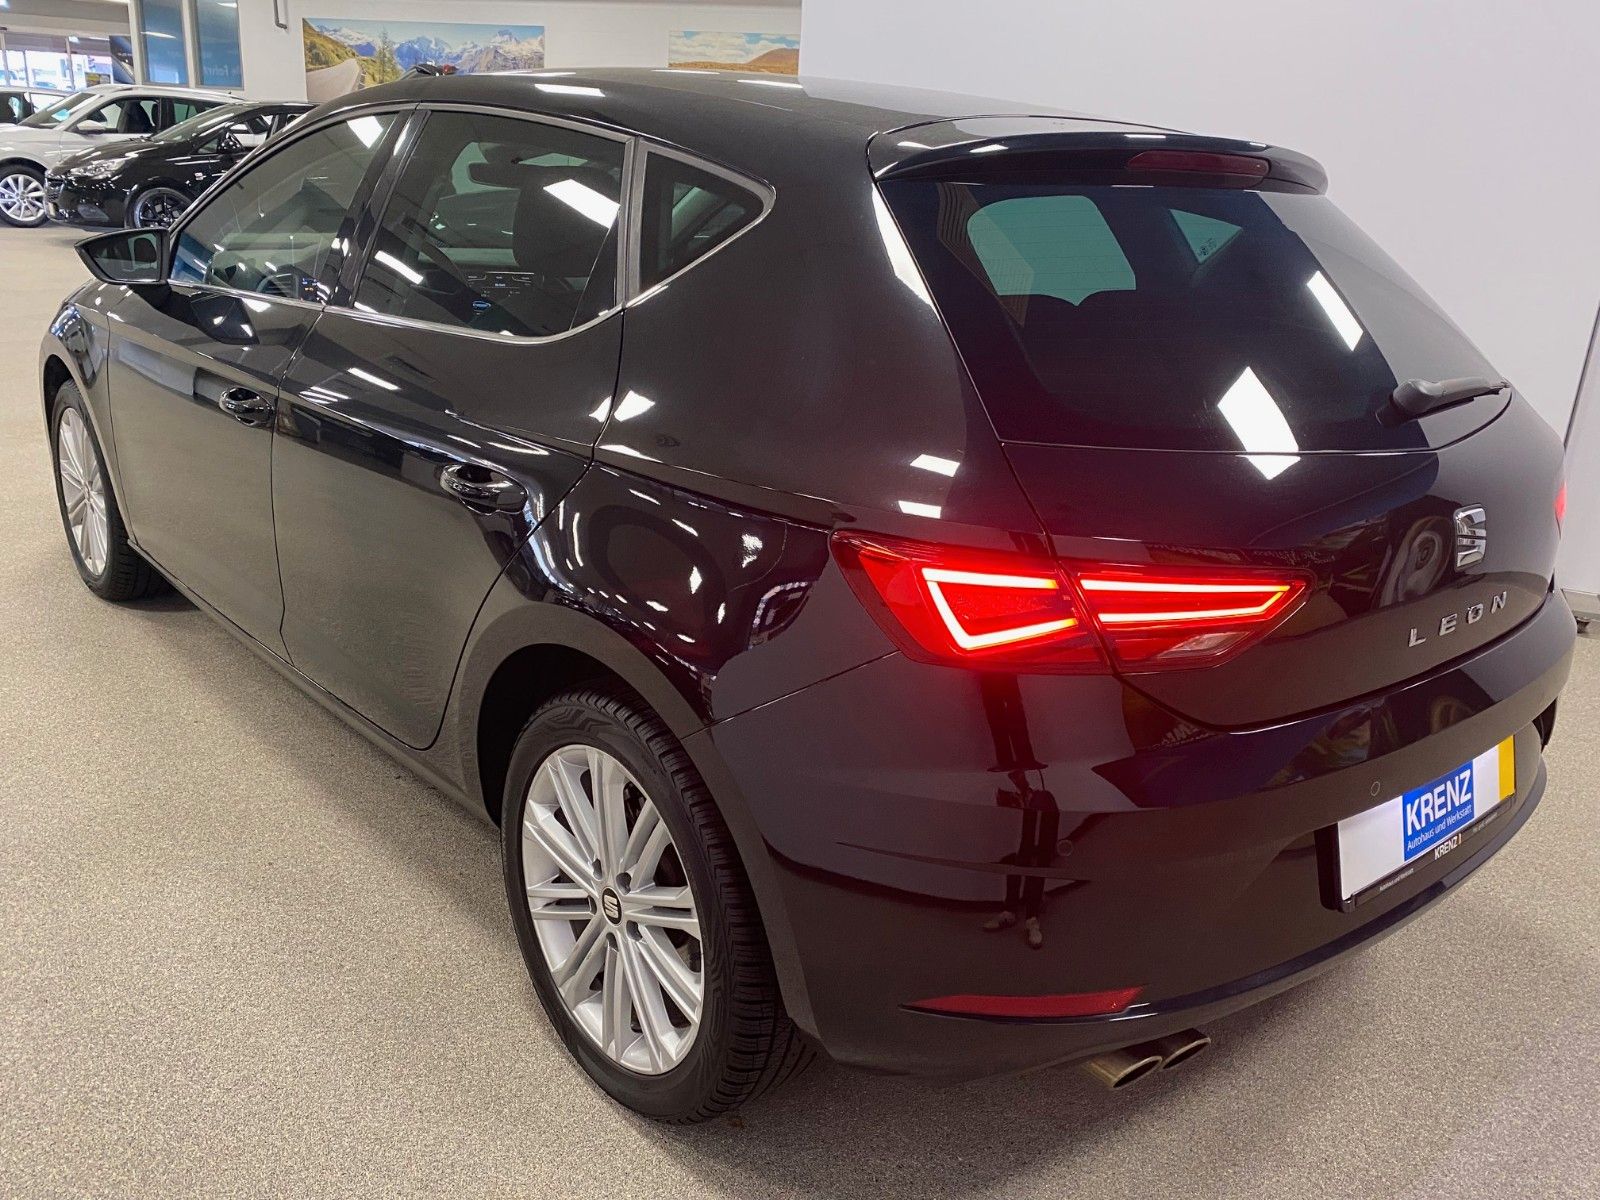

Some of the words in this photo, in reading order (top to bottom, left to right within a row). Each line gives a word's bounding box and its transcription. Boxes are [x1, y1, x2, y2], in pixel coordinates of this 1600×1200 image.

[1408, 591, 1507, 648] LEON
[1406, 769, 1472, 836] KRENZ
[1407, 829, 1435, 851] Autohaus
[1434, 818, 1447, 834] und
[1434, 835, 1458, 860] KRENZ
